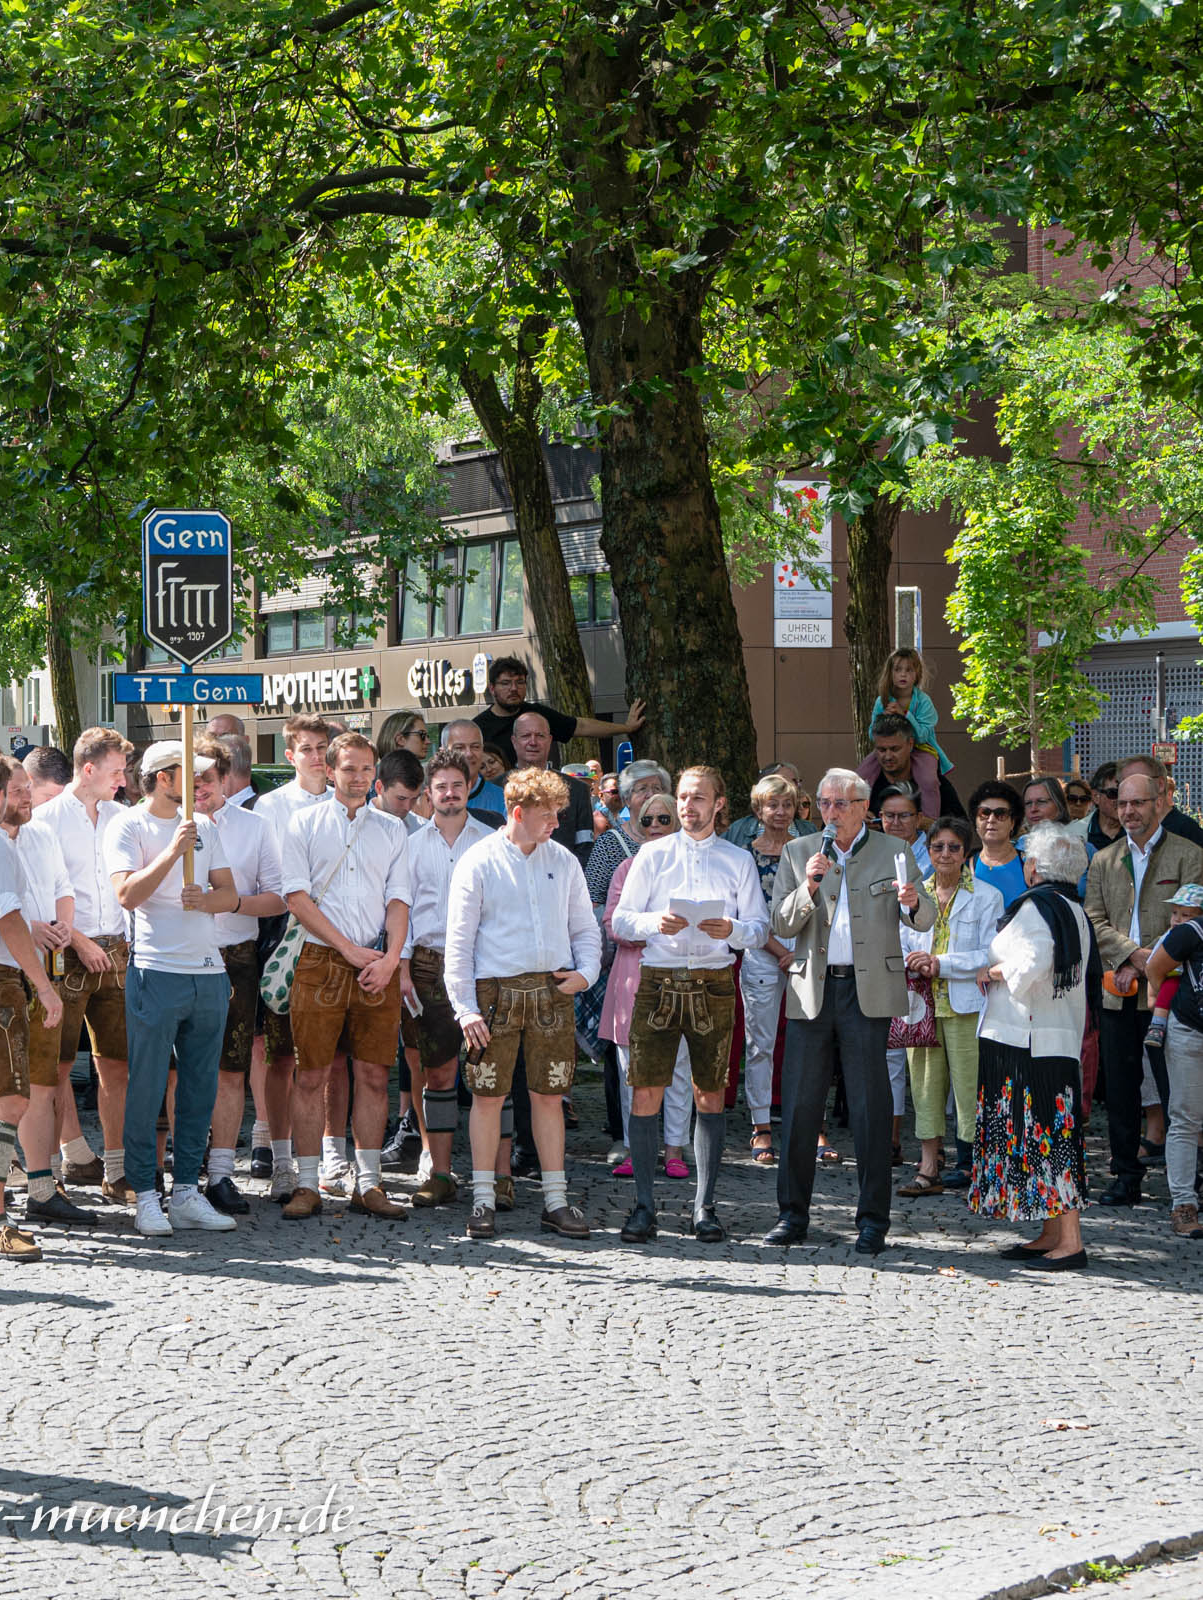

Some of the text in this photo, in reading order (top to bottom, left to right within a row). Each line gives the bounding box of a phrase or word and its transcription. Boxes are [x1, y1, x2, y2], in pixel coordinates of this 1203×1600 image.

[153, 518, 224, 549] Gern
[781, 633, 827, 644] SCHMUCK
[788, 623, 820, 633] UHREN
[193, 678, 248, 701] Gern
[261, 667, 358, 706] APOTHEKE
